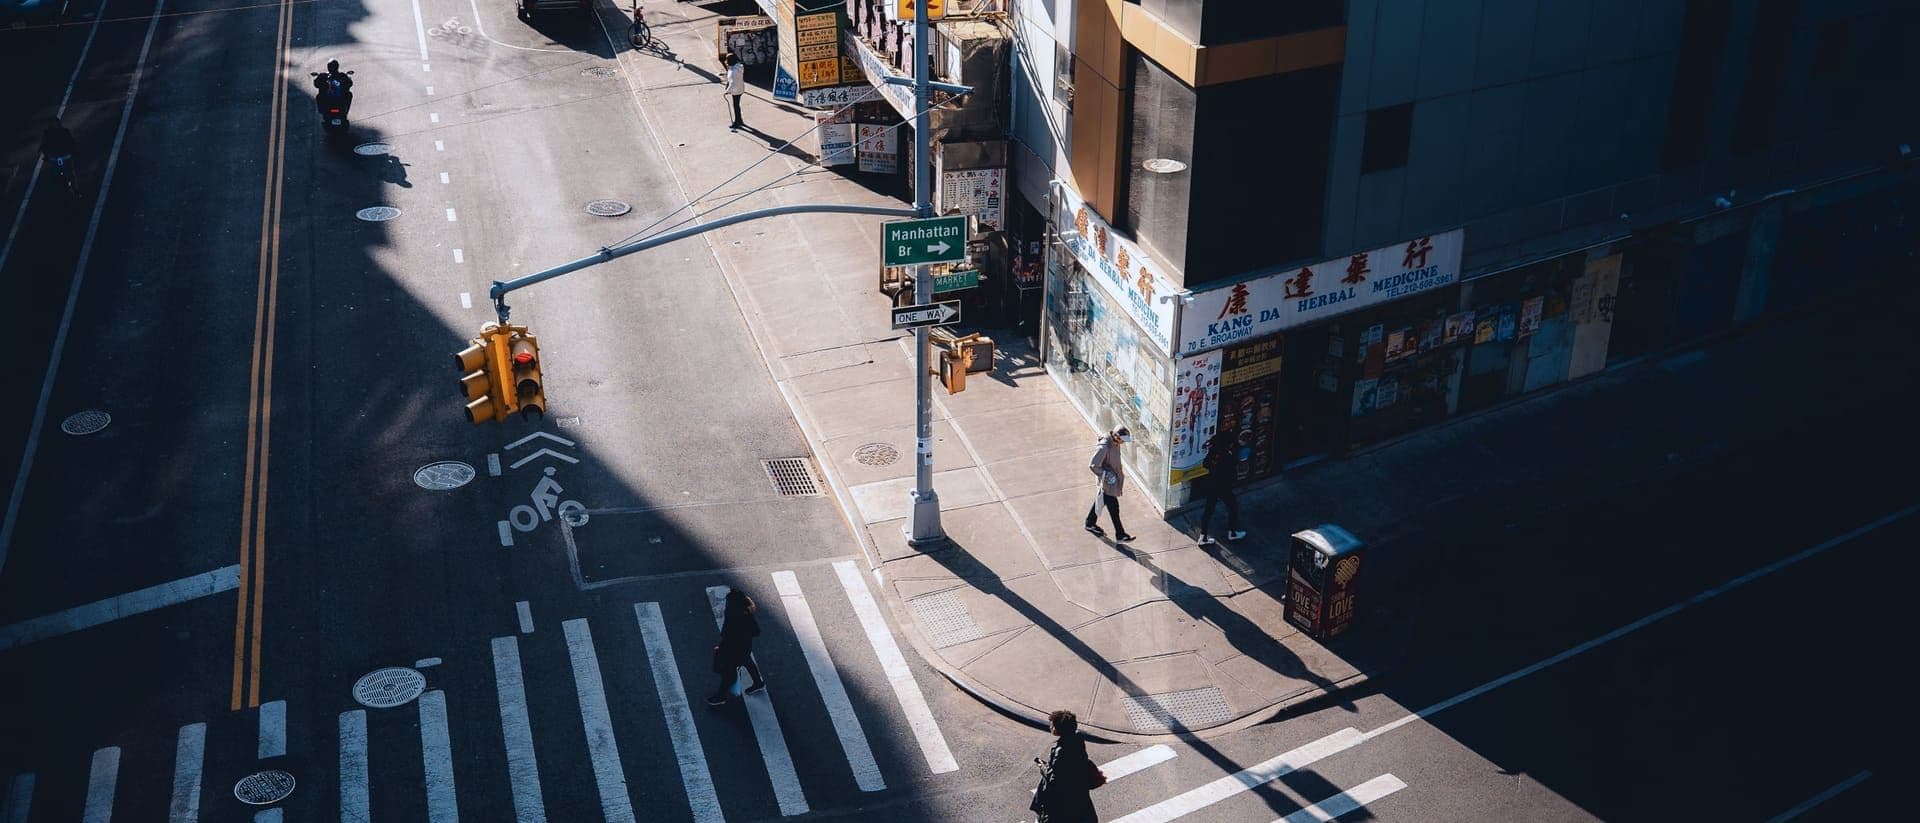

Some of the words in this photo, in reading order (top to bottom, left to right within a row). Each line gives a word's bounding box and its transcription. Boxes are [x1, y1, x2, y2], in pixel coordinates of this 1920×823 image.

[892, 226, 959, 241] Manhattan
[898, 246, 912, 257] Br
[936, 276, 967, 286] MARKET
[1100, 257, 1124, 291] HERBAL
[1128, 287, 1160, 328] MEDICINE
[1208, 314, 1253, 336] KANG
[1260, 307, 1280, 323] DA
[1297, 287, 1357, 312] HERBAL
[1373, 265, 1438, 293] MEDICINE
[899, 313, 917, 323] ONE
[927, 310, 946, 319] WAY
[1188, 341, 1197, 351] 70
[1210, 326, 1254, 346] BROADWAY
[1291, 591, 1310, 609] LOVE
[1329, 594, 1354, 619] LOVE
